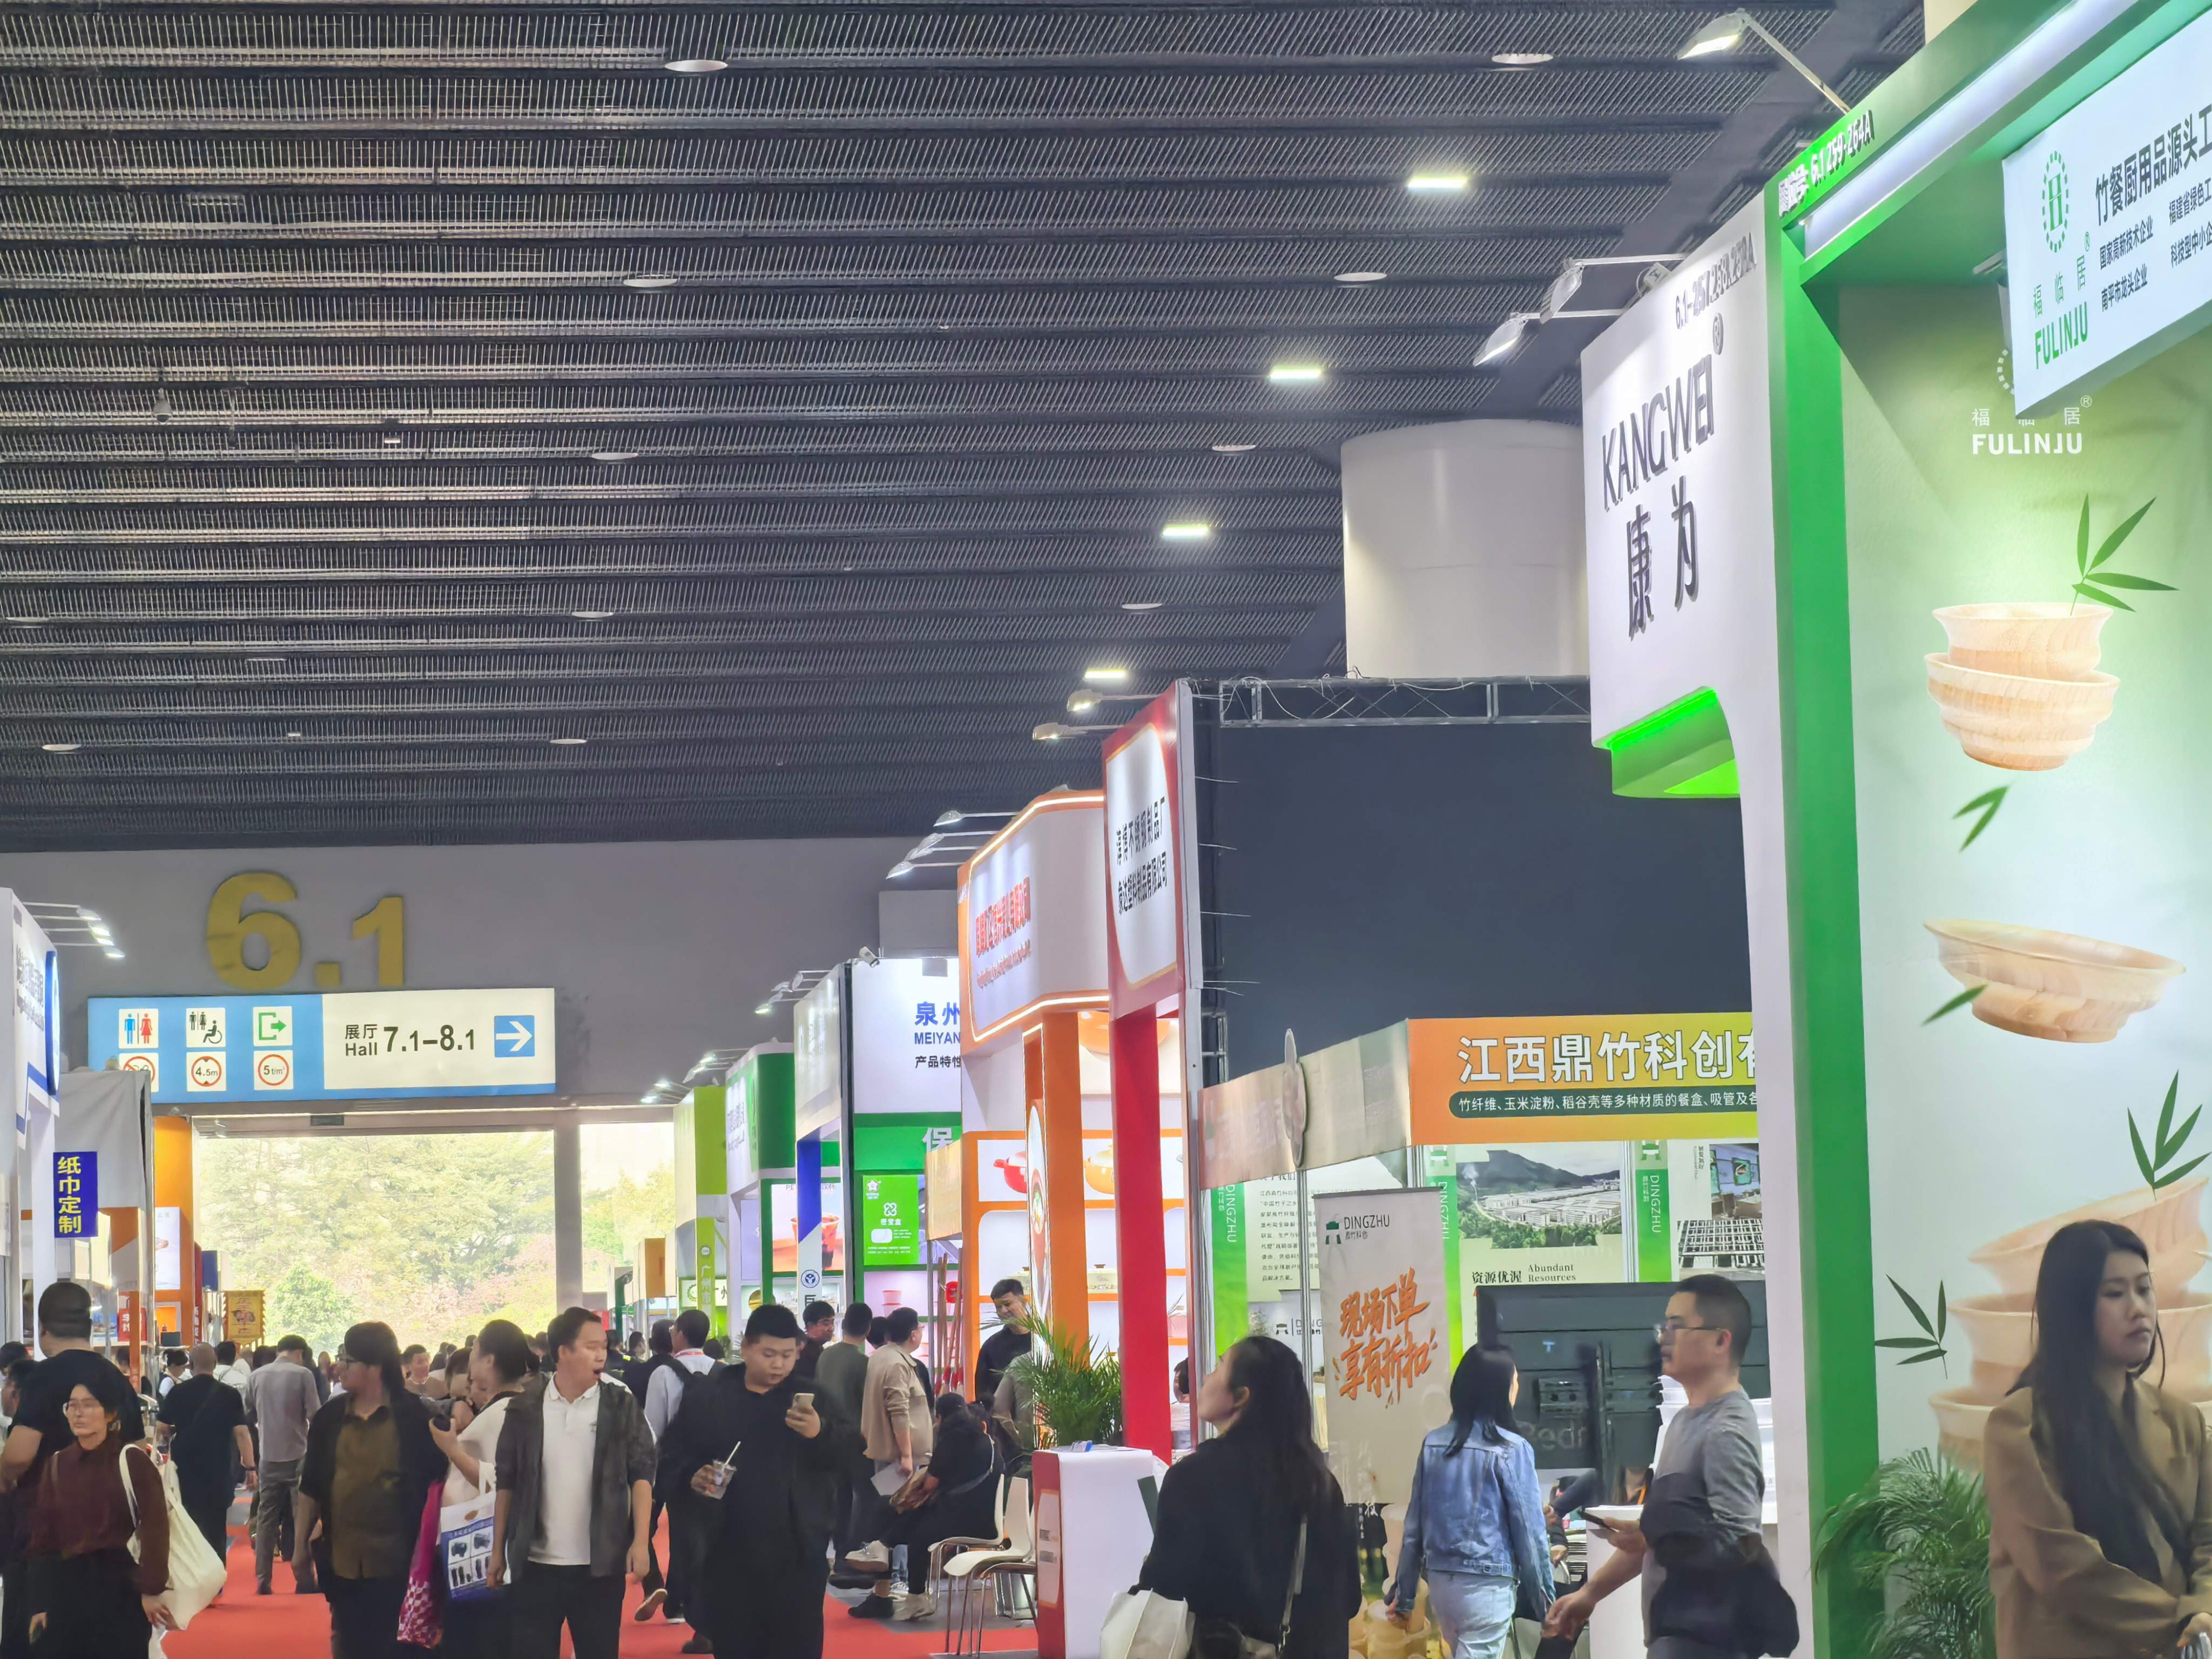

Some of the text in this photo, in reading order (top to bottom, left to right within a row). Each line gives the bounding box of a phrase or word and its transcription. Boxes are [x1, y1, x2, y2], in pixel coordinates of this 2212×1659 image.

[2095, 103, 2212, 226] 竹餐厨用品源头工
[2169, 177, 2212, 225] 福建省绿色工
[2100, 215, 2153, 269] 国家高新技术企业
[2033, 255, 2086, 319] 福临居
[2102, 263, 2148, 312] 南平市龙头企业
[2035, 301, 2088, 369] FULINJU
[1602, 354, 1714, 512] KANGWEI
[1972, 433, 2082, 455] FULINJU
[1627, 474, 1700, 641] 康为
[206, 870, 405, 991] 6.1
[345, 1024, 378, 1040] 展厅
[346, 1042, 377, 1057] Hall
[914, 1031, 961, 1045] MEIYAN
[195, 1067, 218, 1077] 4.5m
[922, 1127, 953, 1152] 保
[57, 1156, 82, 1234] 纸巾定制
[1650, 1175, 1661, 1233] DINGZHU
[1344, 1215, 1390, 1230] DINGZHU
[1528, 1264, 1574, 1272] Abundant
[1528, 1273, 1576, 1282] Resources
[1339, 1267, 1431, 1345] 现场下单
[1339, 1331, 1432, 1404] 享有折扣
